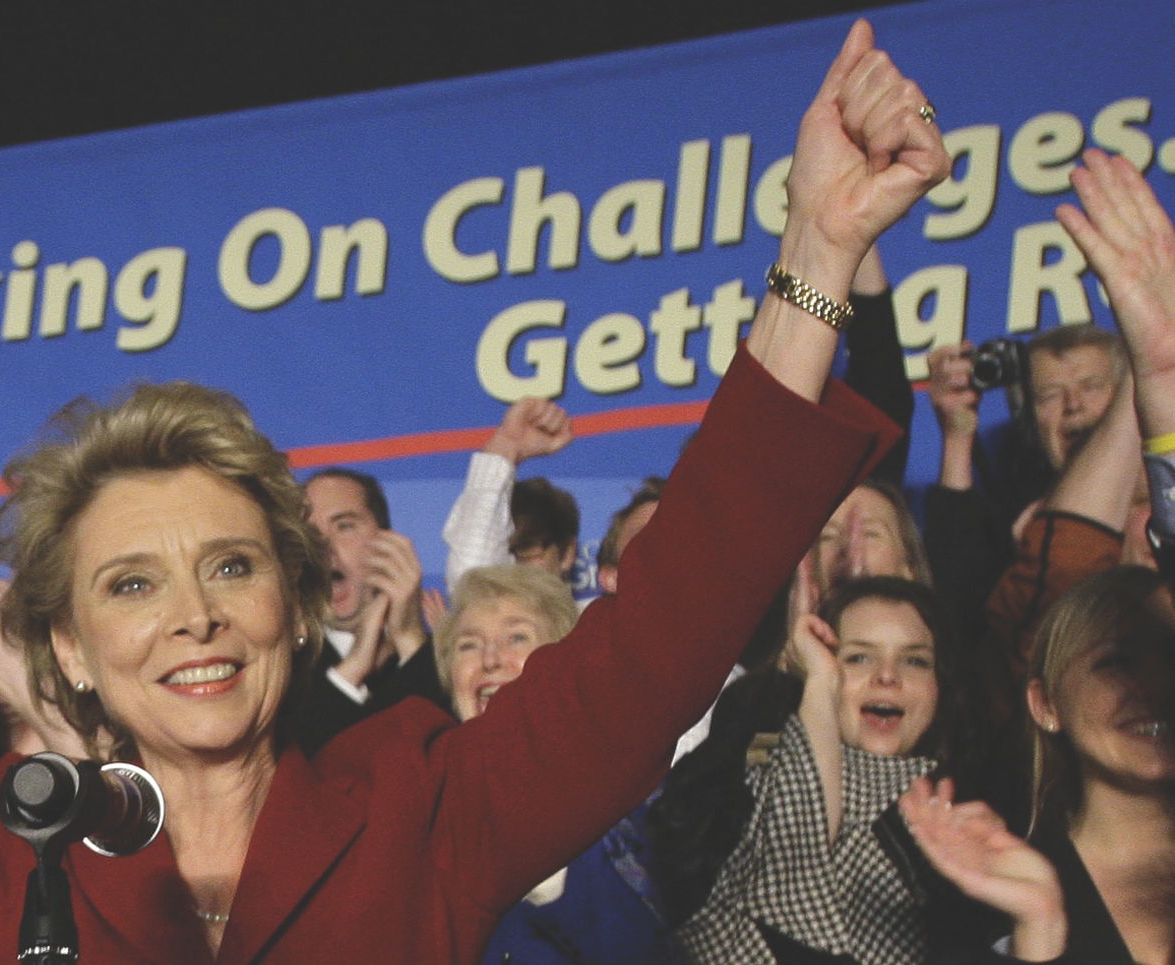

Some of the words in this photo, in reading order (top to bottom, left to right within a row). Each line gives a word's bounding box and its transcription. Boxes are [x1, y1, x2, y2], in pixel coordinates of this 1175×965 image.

[217, 206, 388, 312] On
[422, 97, 1175, 284] Challges.
[475, 264, 968, 402] Gettg
